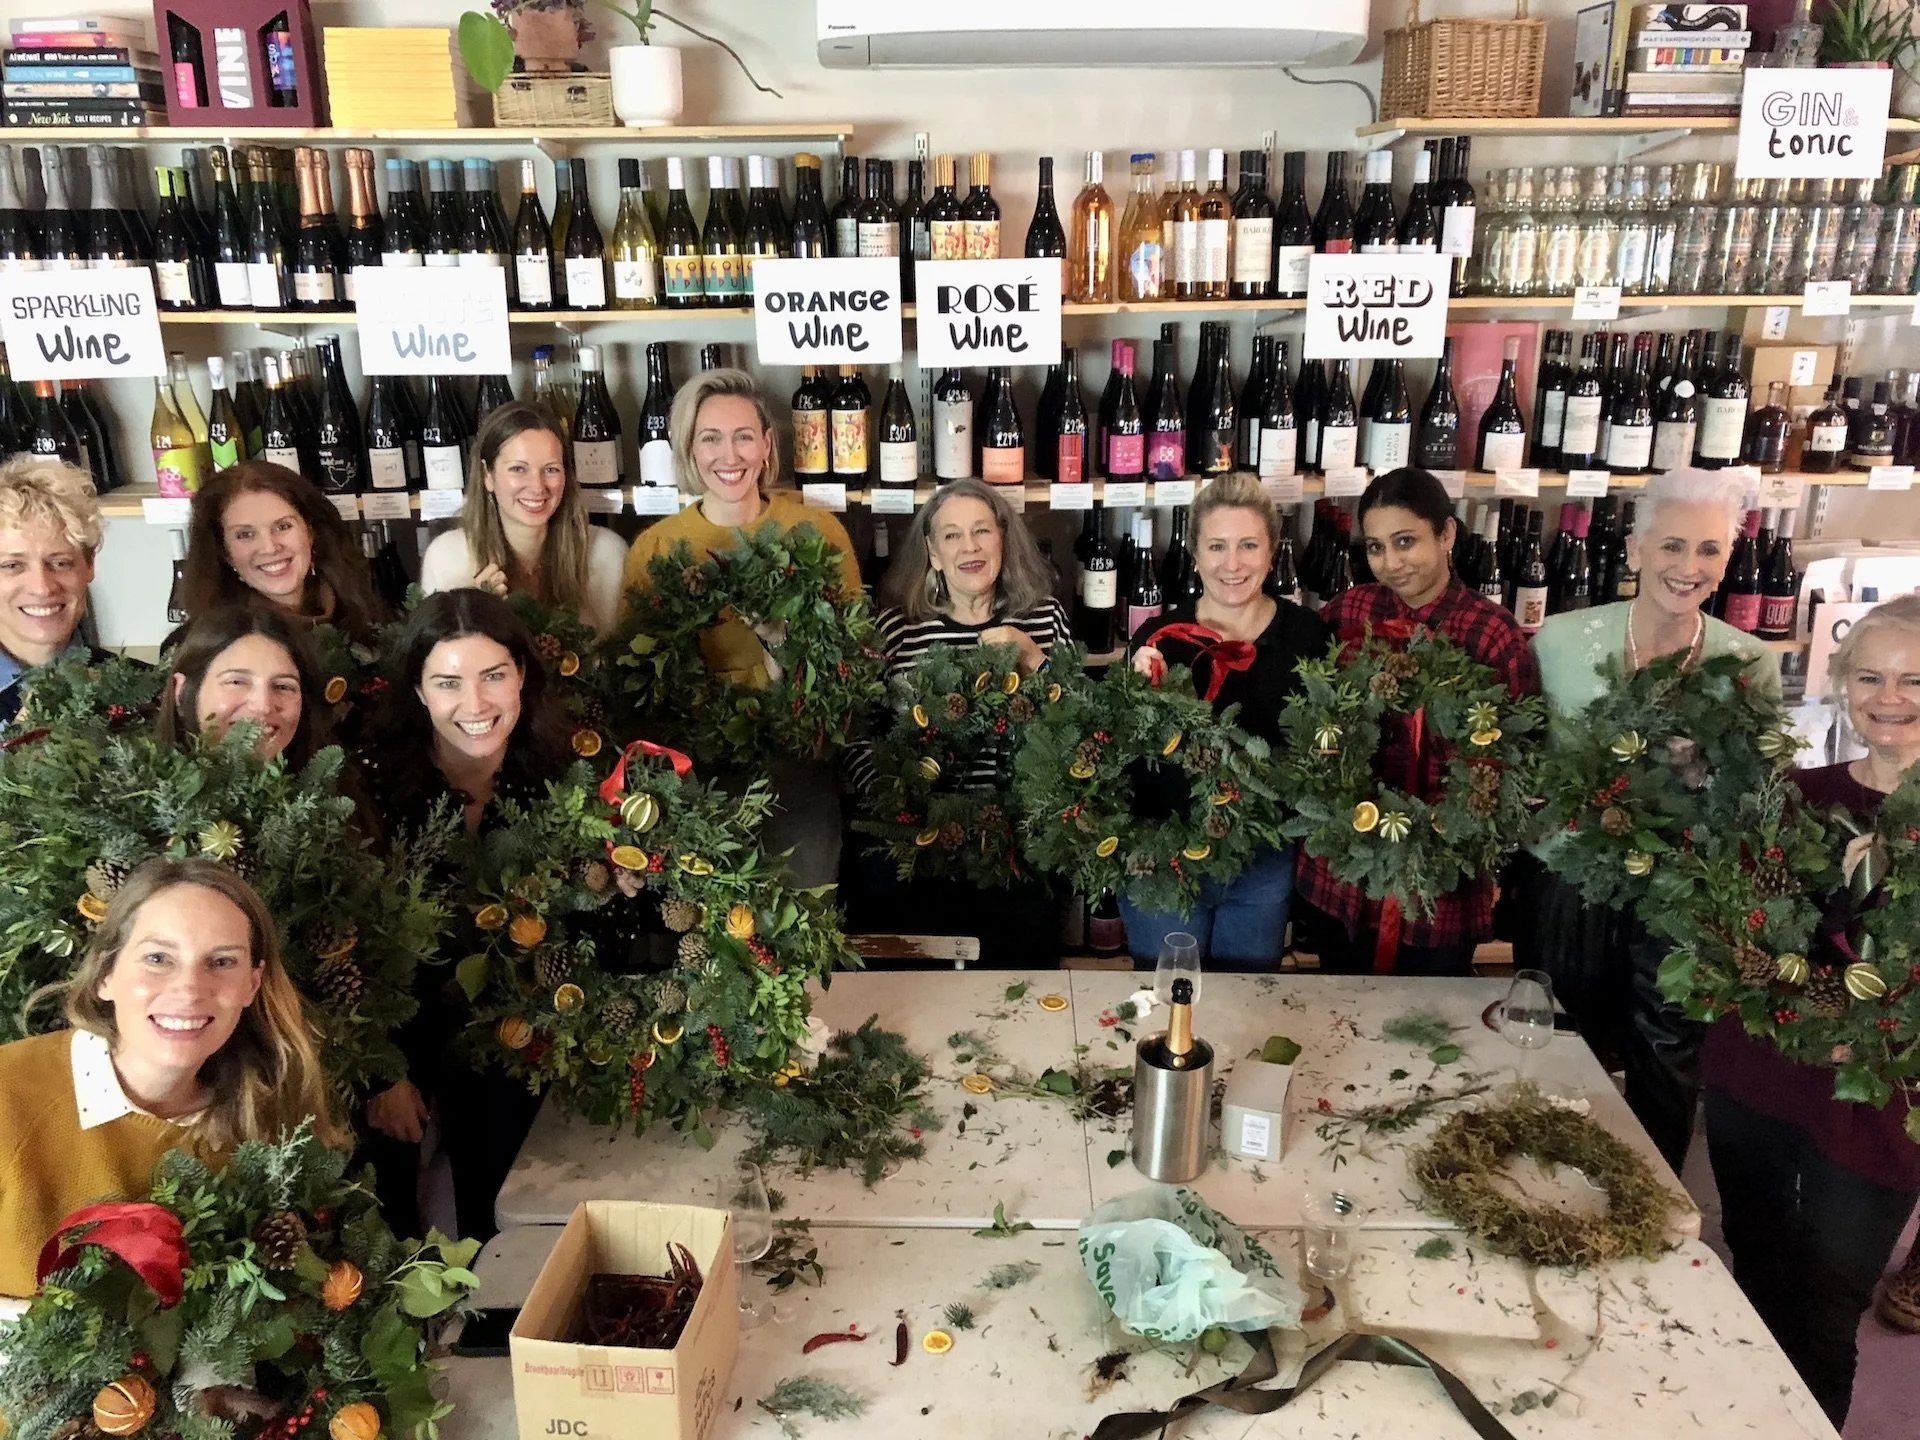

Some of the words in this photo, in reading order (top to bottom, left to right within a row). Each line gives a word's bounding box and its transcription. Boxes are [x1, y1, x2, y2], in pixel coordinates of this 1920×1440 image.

[1762, 91, 1842, 127] GIN
[1769, 127, 1854, 159] tonic
[937, 275, 1040, 314] ROSÉ
[1323, 273, 1434, 308] RED
[36, 324, 131, 365] Wine
[391, 323, 477, 363] Wine
[788, 314, 870, 352] Wine
[949, 315, 1029, 353] Wine
[1337, 308, 1414, 346] Wine
[581, 423, 599, 438] £35
[1093, 1241, 1117, 1310] Save
[545, 1418, 588, 1437] JDC
